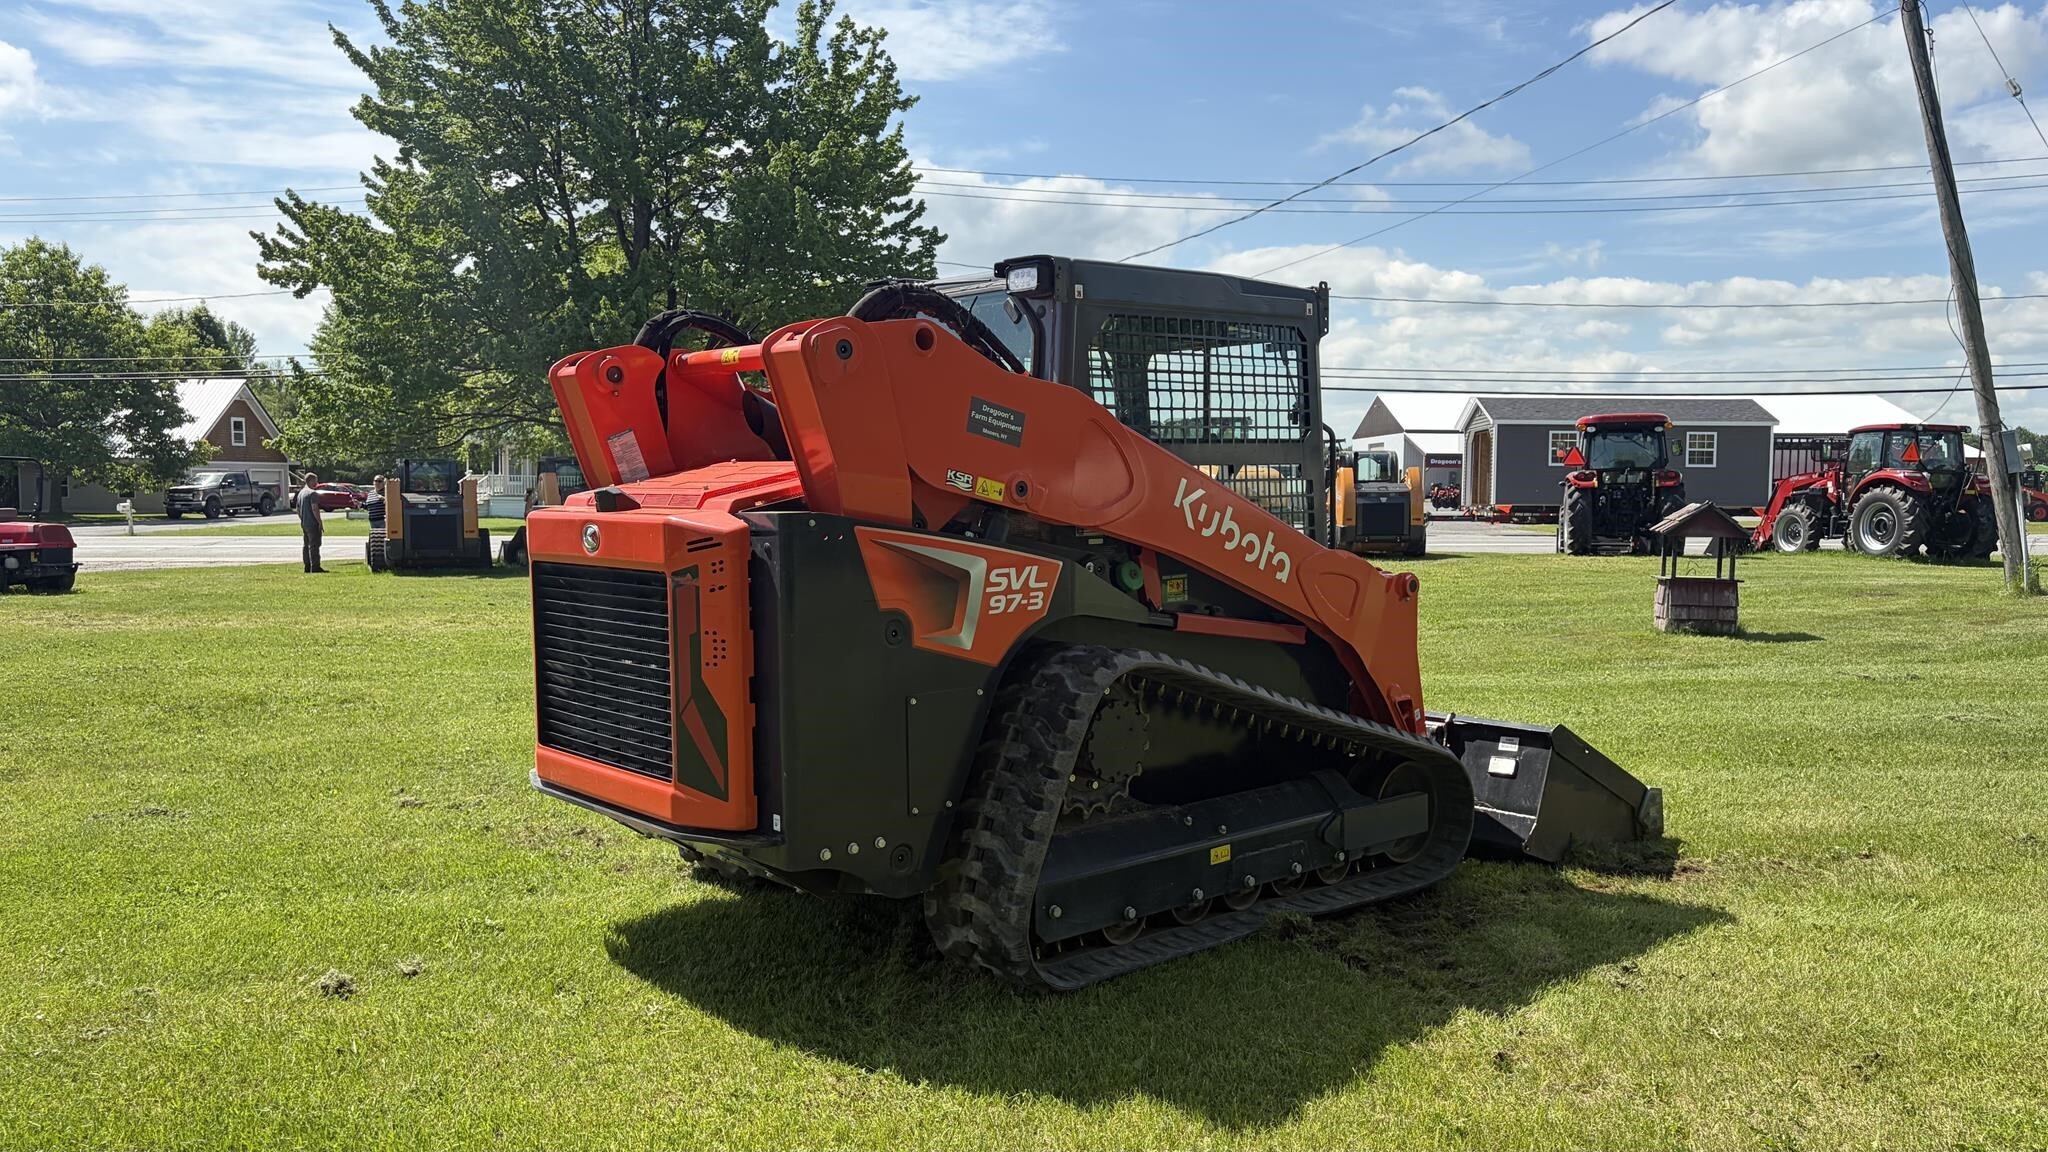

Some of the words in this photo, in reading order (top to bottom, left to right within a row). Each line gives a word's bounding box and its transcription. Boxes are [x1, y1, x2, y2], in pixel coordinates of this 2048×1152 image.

[971, 411, 988, 422] Farm
[988, 416, 1022, 433] Equipment
[982, 404, 1014, 421] Dragoon's
[947, 469, 973, 485] KSR
[1173, 477, 1291, 584] Kubota
[985, 565, 1049, 593] SVL
[988, 591, 1044, 615] 97-3
